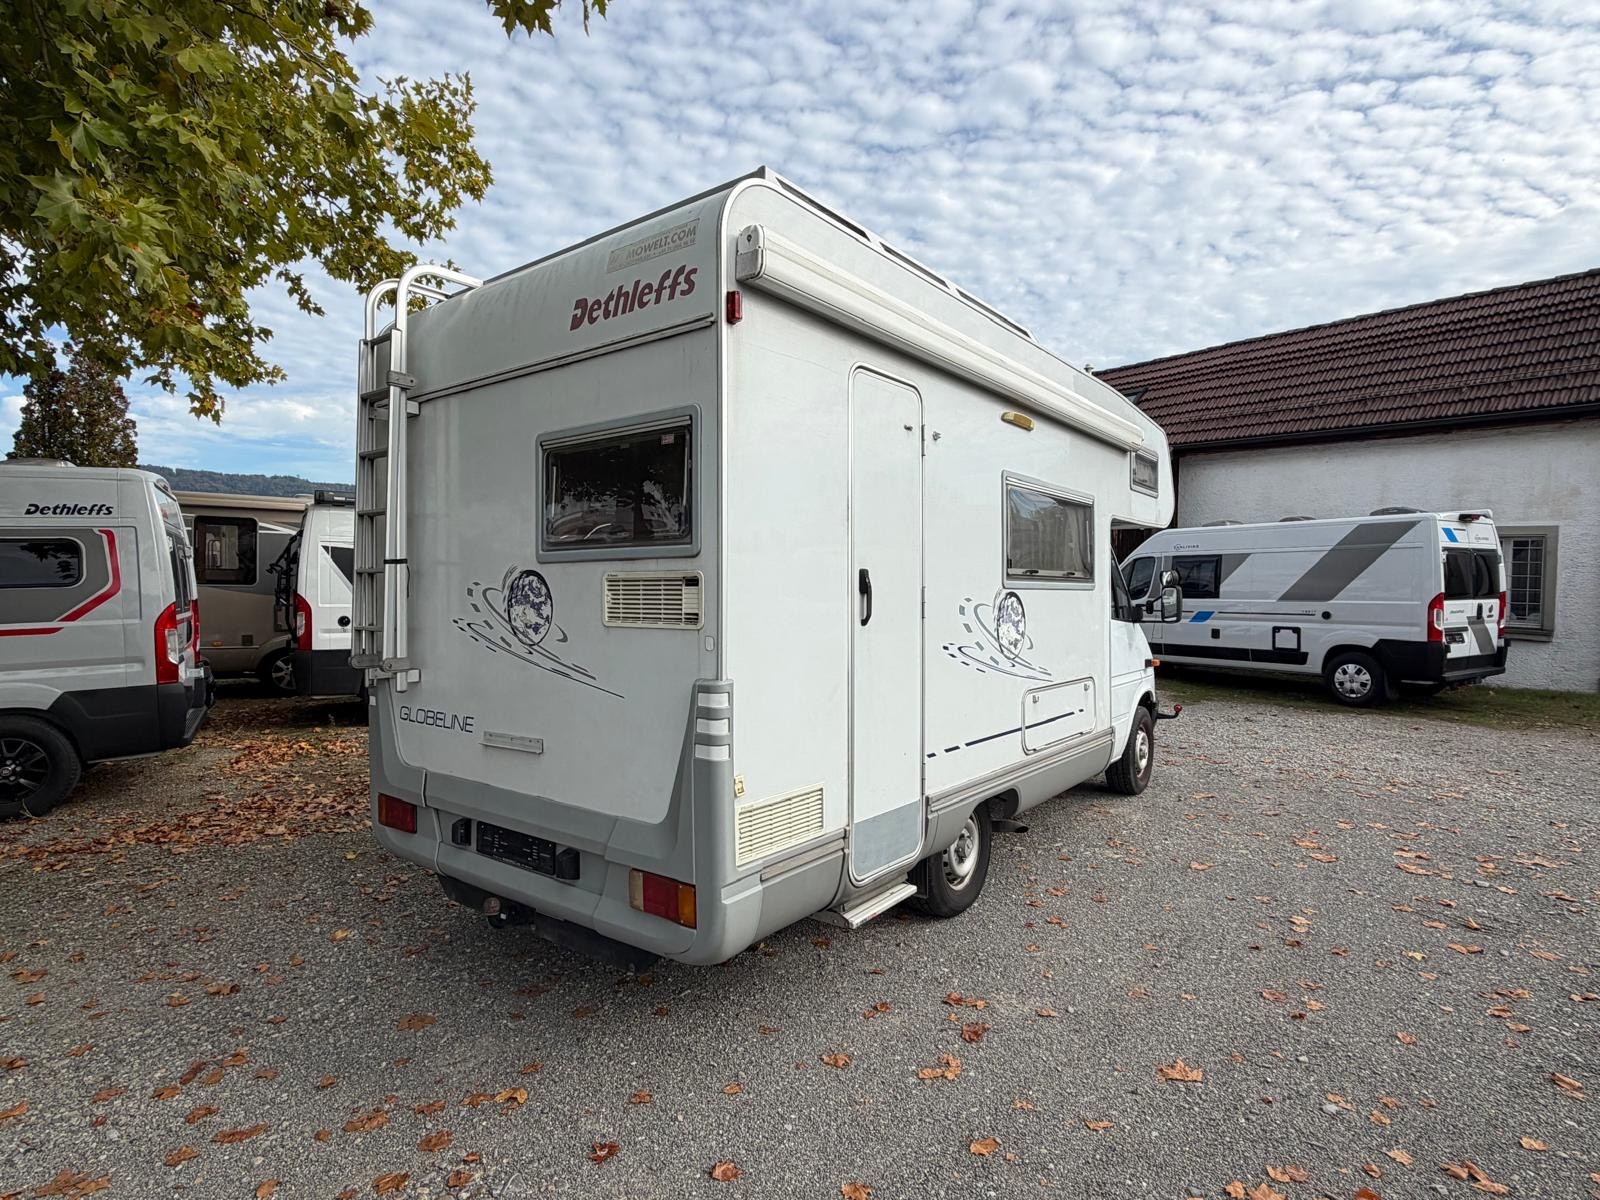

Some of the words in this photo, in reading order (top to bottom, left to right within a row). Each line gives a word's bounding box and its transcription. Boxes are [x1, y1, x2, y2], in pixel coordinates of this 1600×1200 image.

[570, 264, 698, 331] Dethleffs
[24, 503, 114, 516] Dethleffs
[400, 705, 475, 734] GLOBELINE
